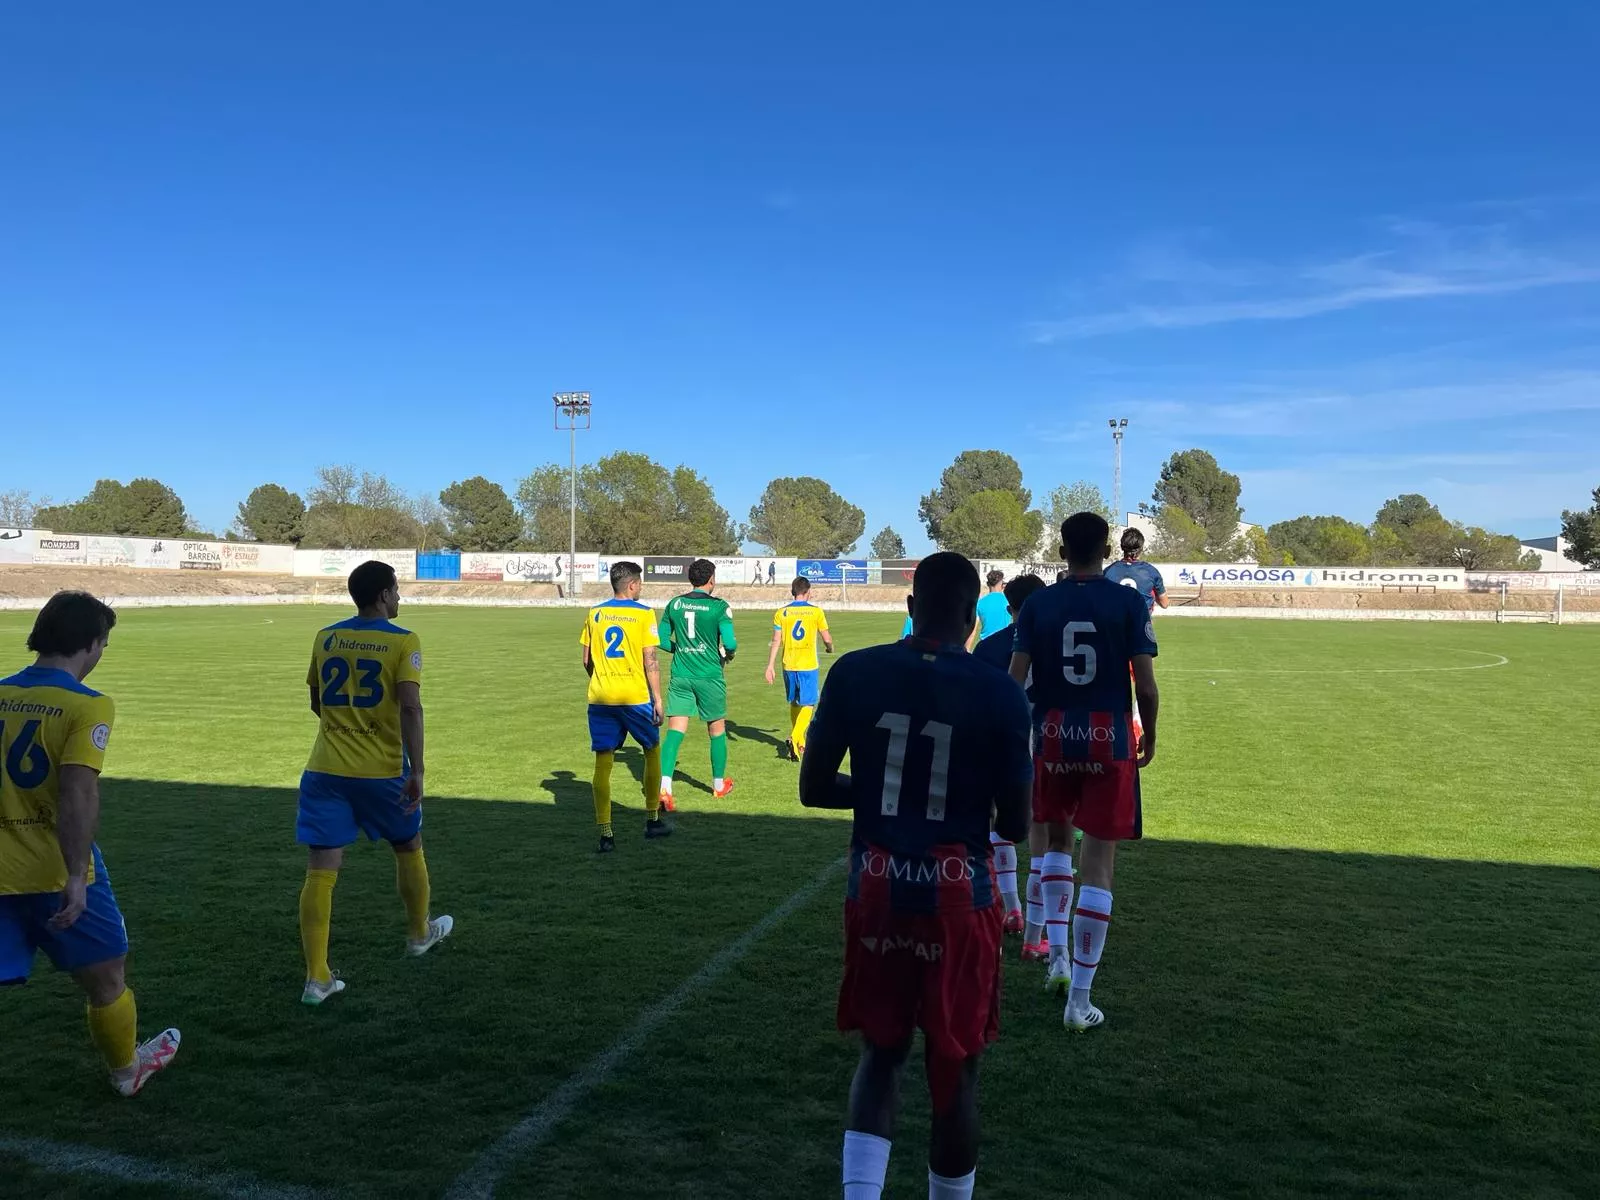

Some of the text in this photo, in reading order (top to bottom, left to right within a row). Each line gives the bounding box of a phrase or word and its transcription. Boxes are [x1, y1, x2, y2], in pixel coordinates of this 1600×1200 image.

[188, 551, 220, 560] BARREÑA
[1201, 569, 1295, 581] LASAOSA
[1322, 570, 1458, 582] hidroman
[682, 602, 709, 611] hidroman
[604, 615, 637, 624] hidroman
[685, 611, 695, 639] 1
[792, 620, 805, 641] 6
[339, 639, 388, 653] hidroman
[604, 625, 625, 658] 2
[1062, 621, 1097, 686] 5
[321, 655, 384, 708] 23
[875, 712, 953, 822] 11
[860, 851, 976, 883] SOMMOS
